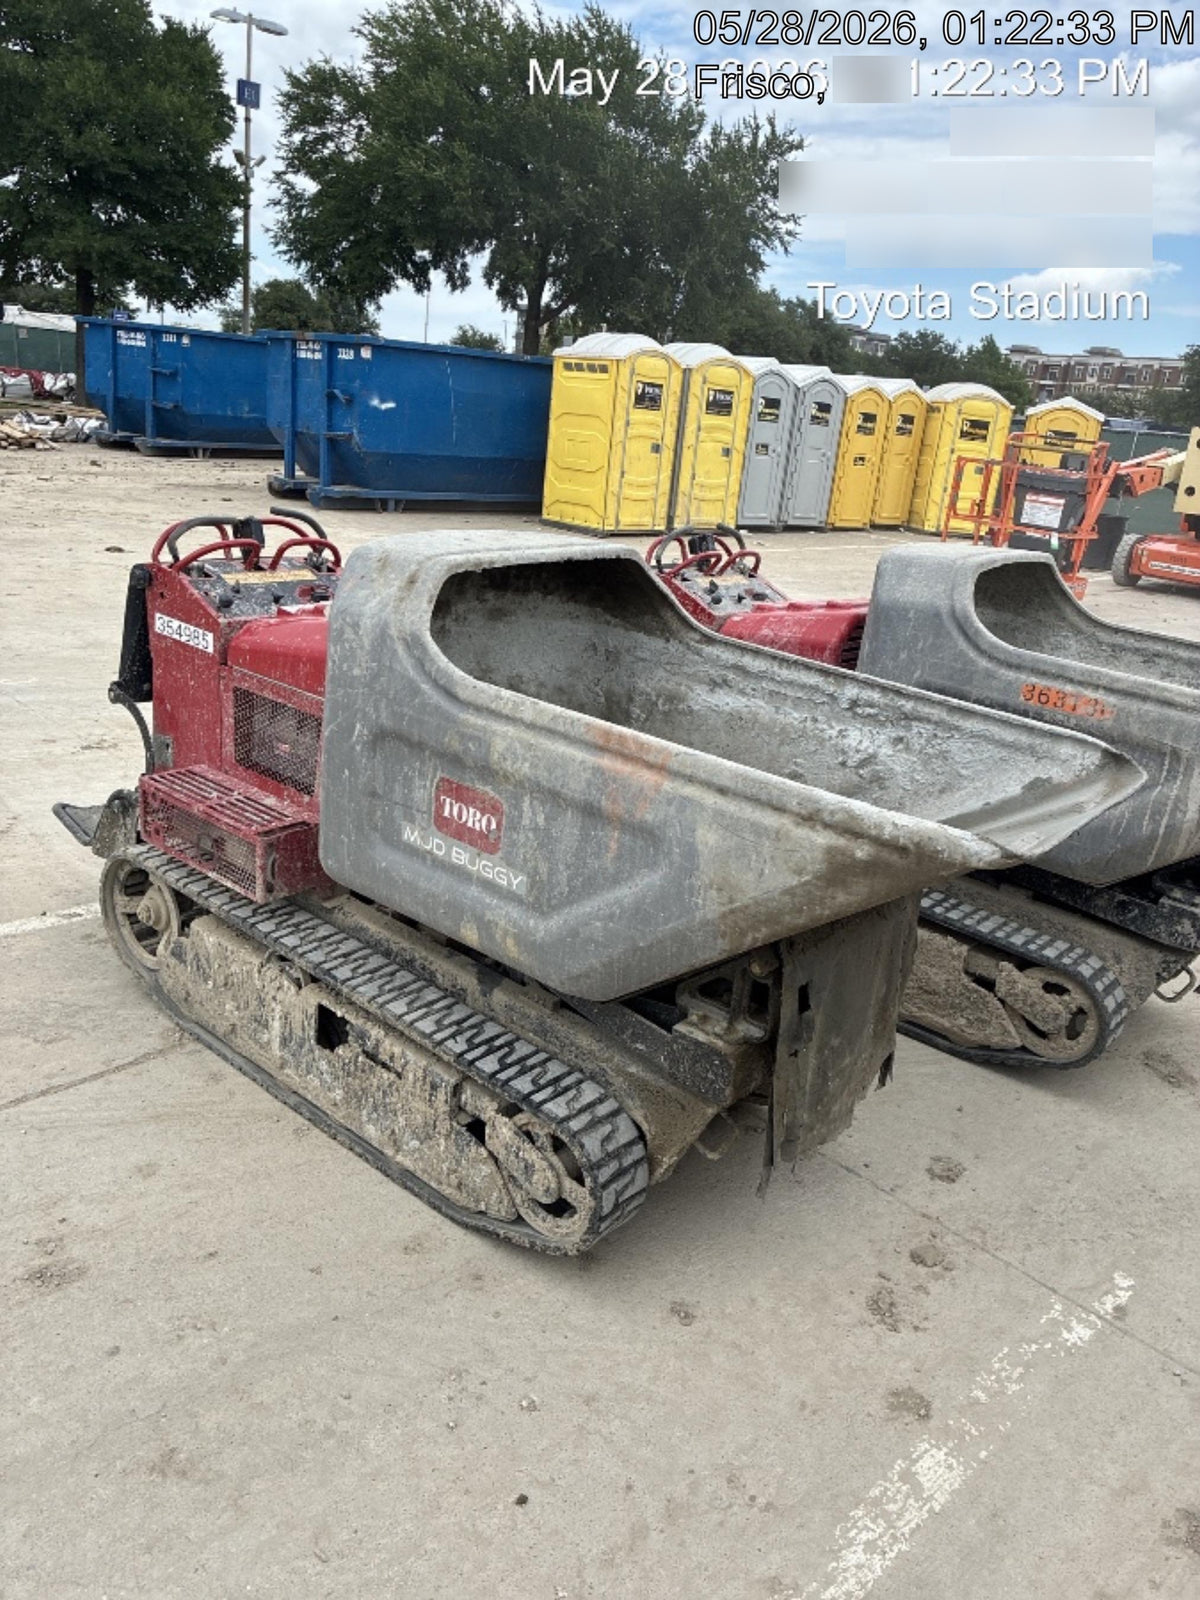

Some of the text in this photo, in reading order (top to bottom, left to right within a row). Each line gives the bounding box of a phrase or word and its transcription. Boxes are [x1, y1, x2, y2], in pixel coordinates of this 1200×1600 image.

[157, 616, 210, 650] 354985
[440, 796, 498, 835] TORO
[452, 847, 524, 890] BUGGY
